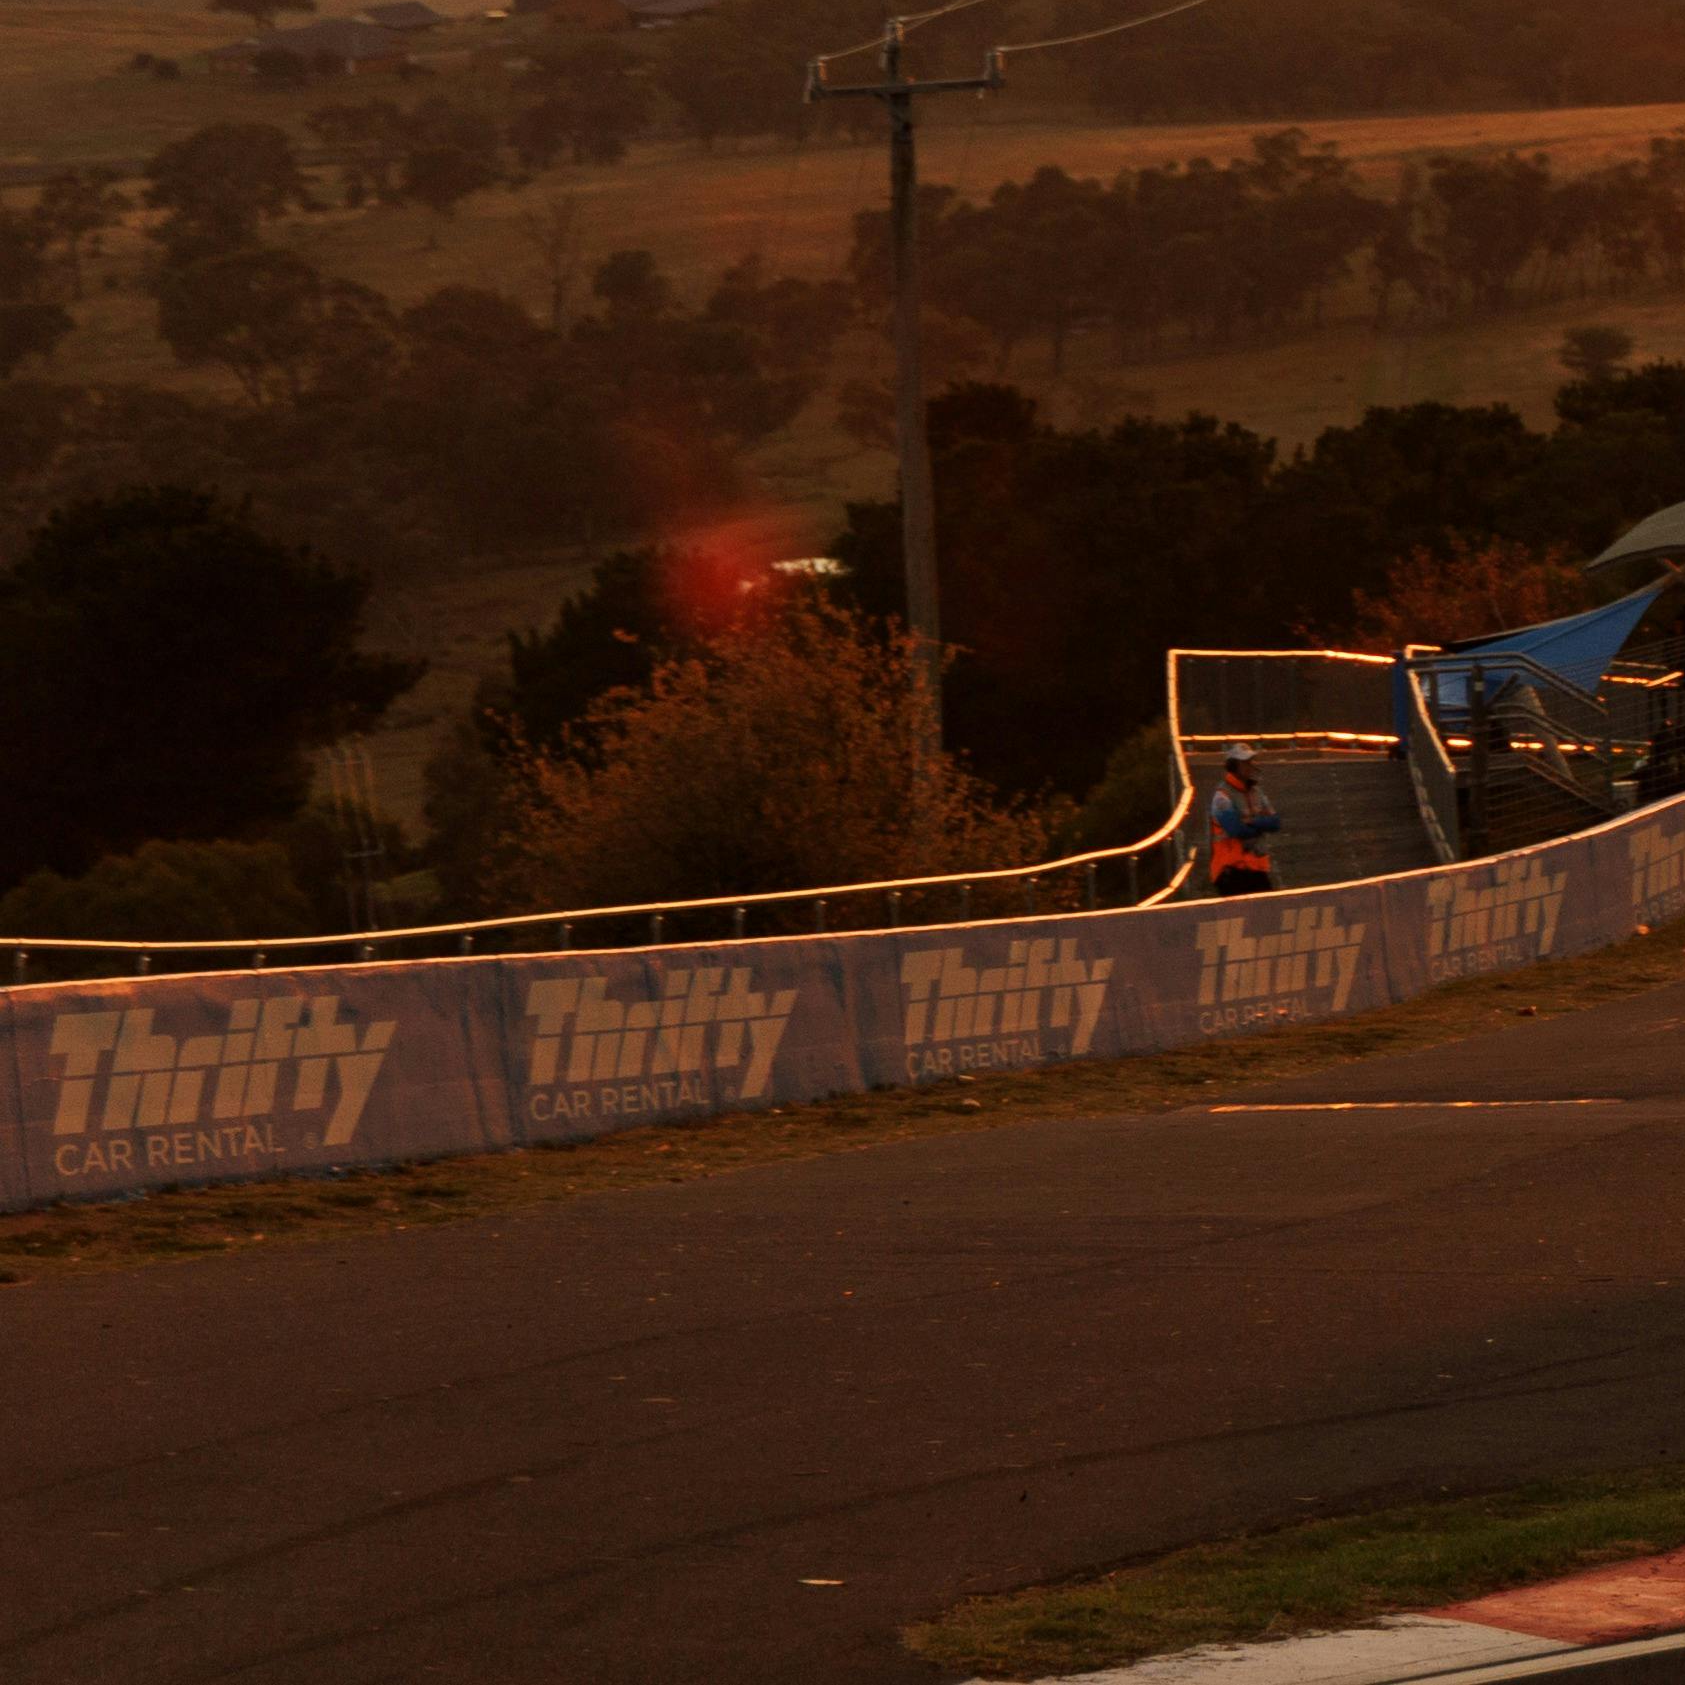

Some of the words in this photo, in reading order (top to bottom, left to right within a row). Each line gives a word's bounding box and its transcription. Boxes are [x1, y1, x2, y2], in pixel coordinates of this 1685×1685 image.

[1195, 906, 1367, 1011] Thrifty
[1426, 858, 1569, 958] Thrifty
[525, 966, 800, 1100] Thrifty
[901, 938, 1115, 1056] Thrifty
[49, 995, 397, 1146] Thrifty
[530, 1090, 592, 1122] CAR
[602, 1081, 711, 1115] RENTAL
[959, 1036, 1047, 1070] RENTAL
[54, 1139, 135, 1177] CAR
[146, 1123, 288, 1168] RENTAL
